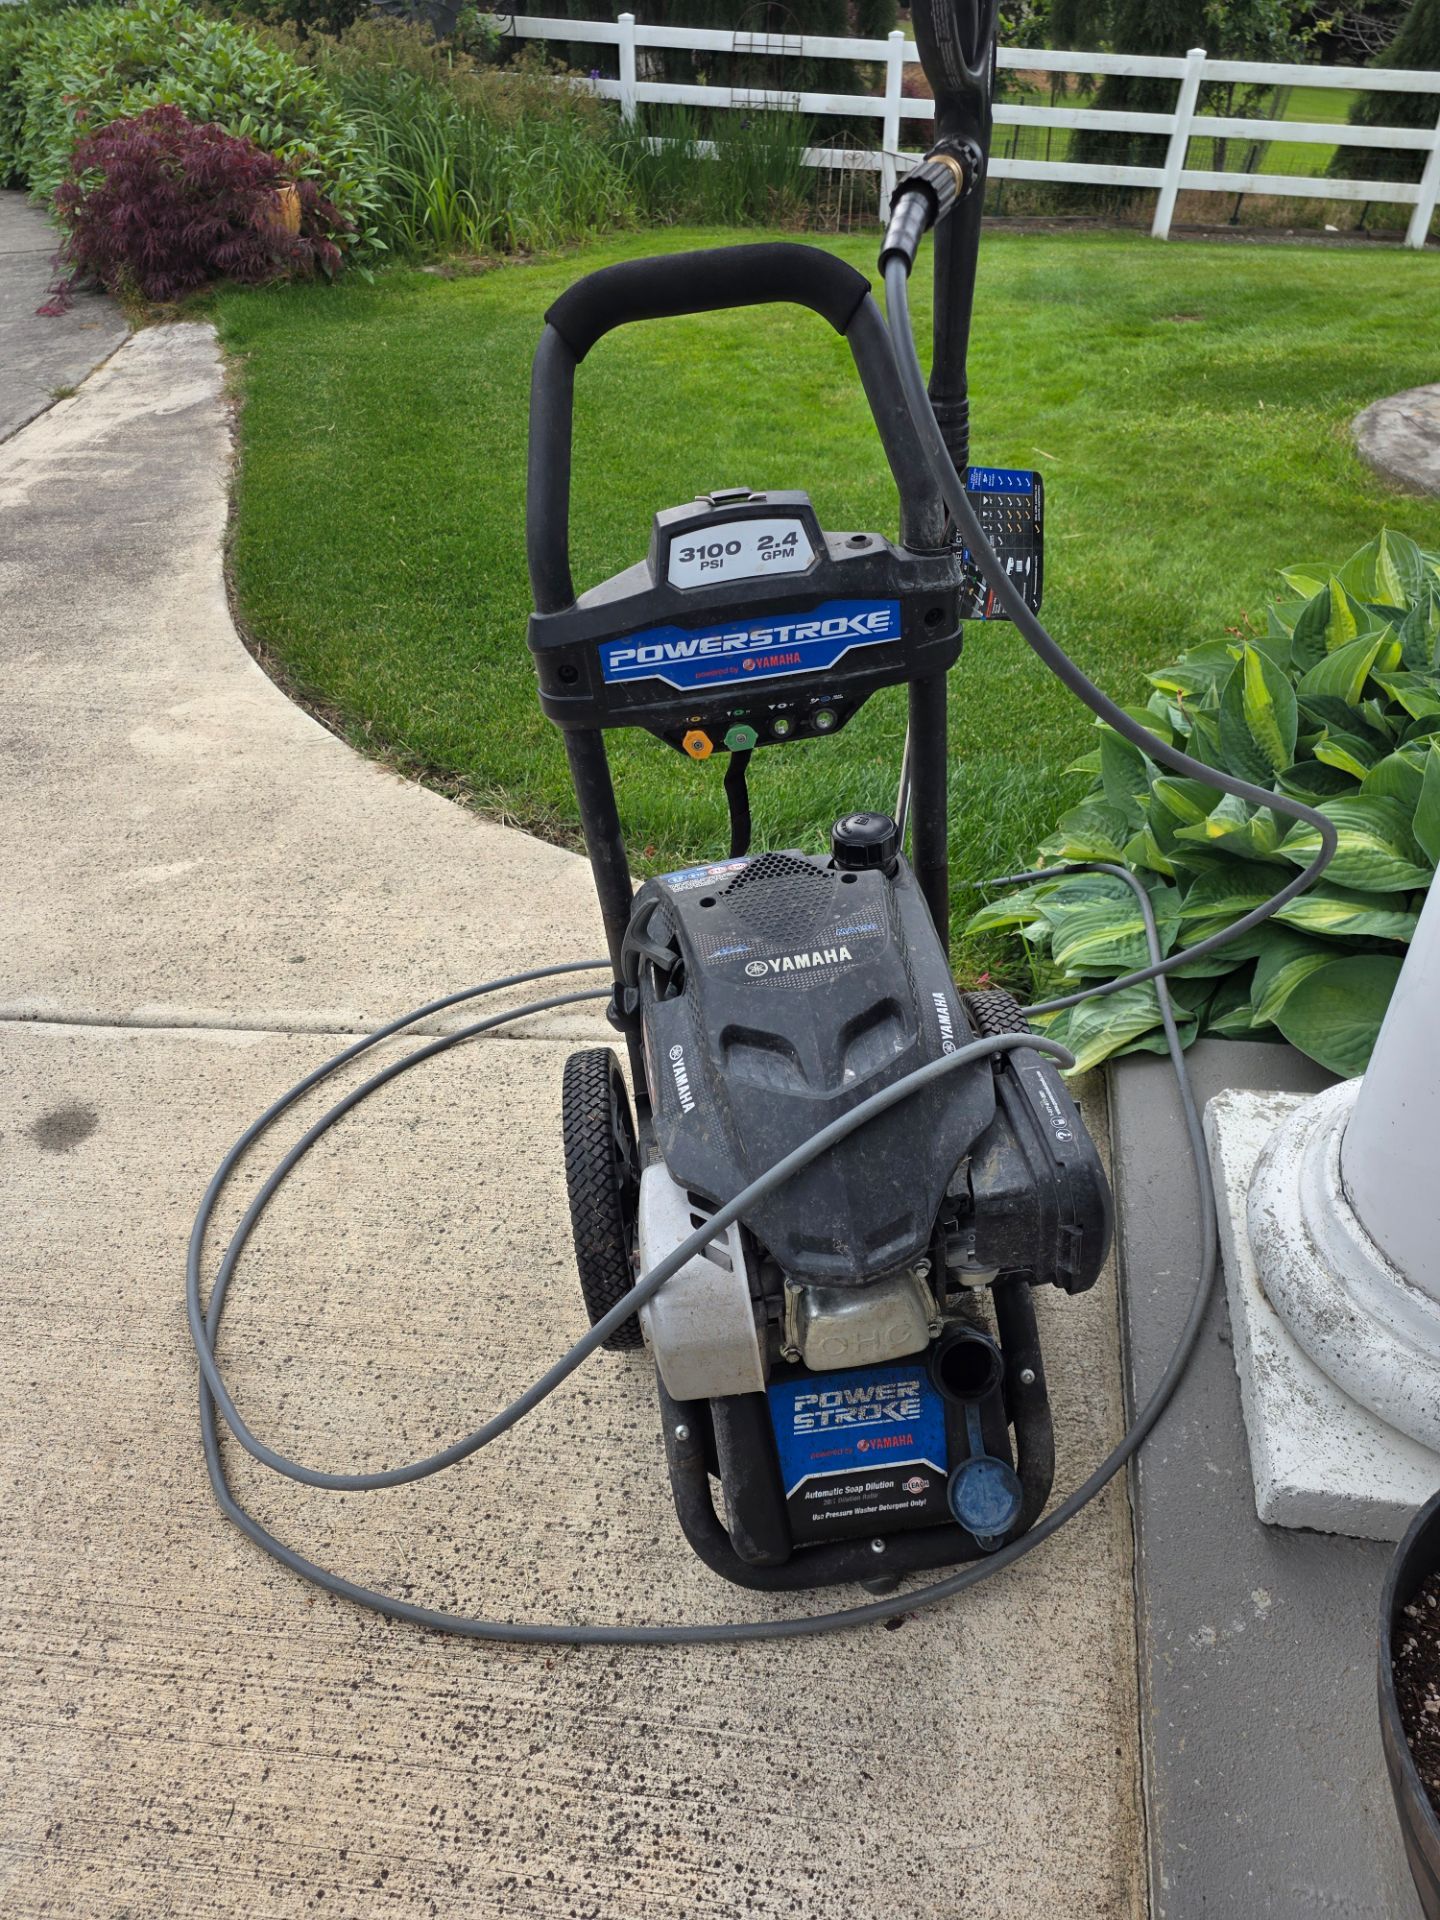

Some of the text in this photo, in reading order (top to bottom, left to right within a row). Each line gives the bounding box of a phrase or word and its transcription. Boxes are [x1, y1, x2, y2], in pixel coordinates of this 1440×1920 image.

[678, 531, 799, 563] 3100 2.4
[700, 547, 795, 571] PSI GPM
[609, 609, 891, 668] POWERSTROKE
[756, 652, 801, 668] YAMAHA
[768, 946, 853, 974] YAMAHA
[932, 992, 954, 1040] YAMAHA
[672, 1057, 696, 1114] YAMAHA
[819, 1322, 912, 1357] OHC
[794, 1380, 920, 1412] POWER
[793, 1398, 921, 1430] STROKE
[870, 1433, 914, 1449] YAMAHA
[804, 1480, 895, 1500] Automatic Soap Dilution
[812, 1498, 927, 1521] Use Pressure Washer Detergent Only!
